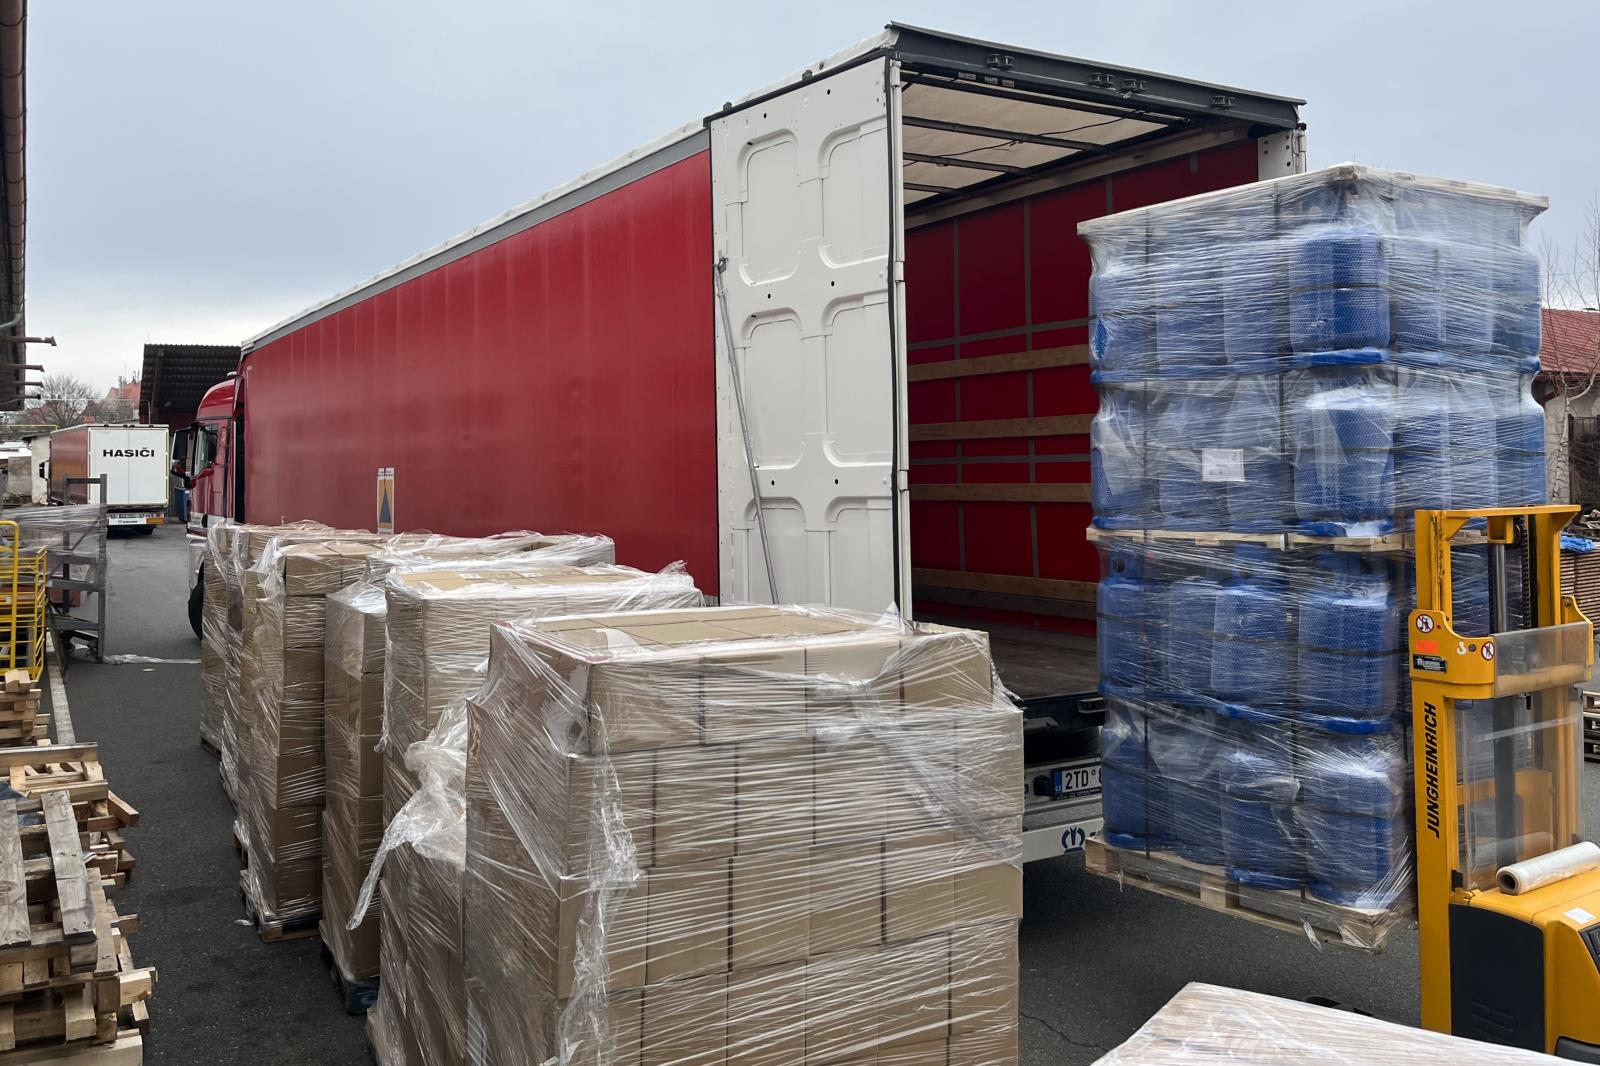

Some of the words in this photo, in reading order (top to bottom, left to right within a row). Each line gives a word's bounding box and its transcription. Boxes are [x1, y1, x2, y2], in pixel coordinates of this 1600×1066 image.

[103, 446, 155, 458] HASIČI
[1065, 769, 1089, 790] 2TD
[1423, 701, 1440, 839] JUNGHEINRICH
